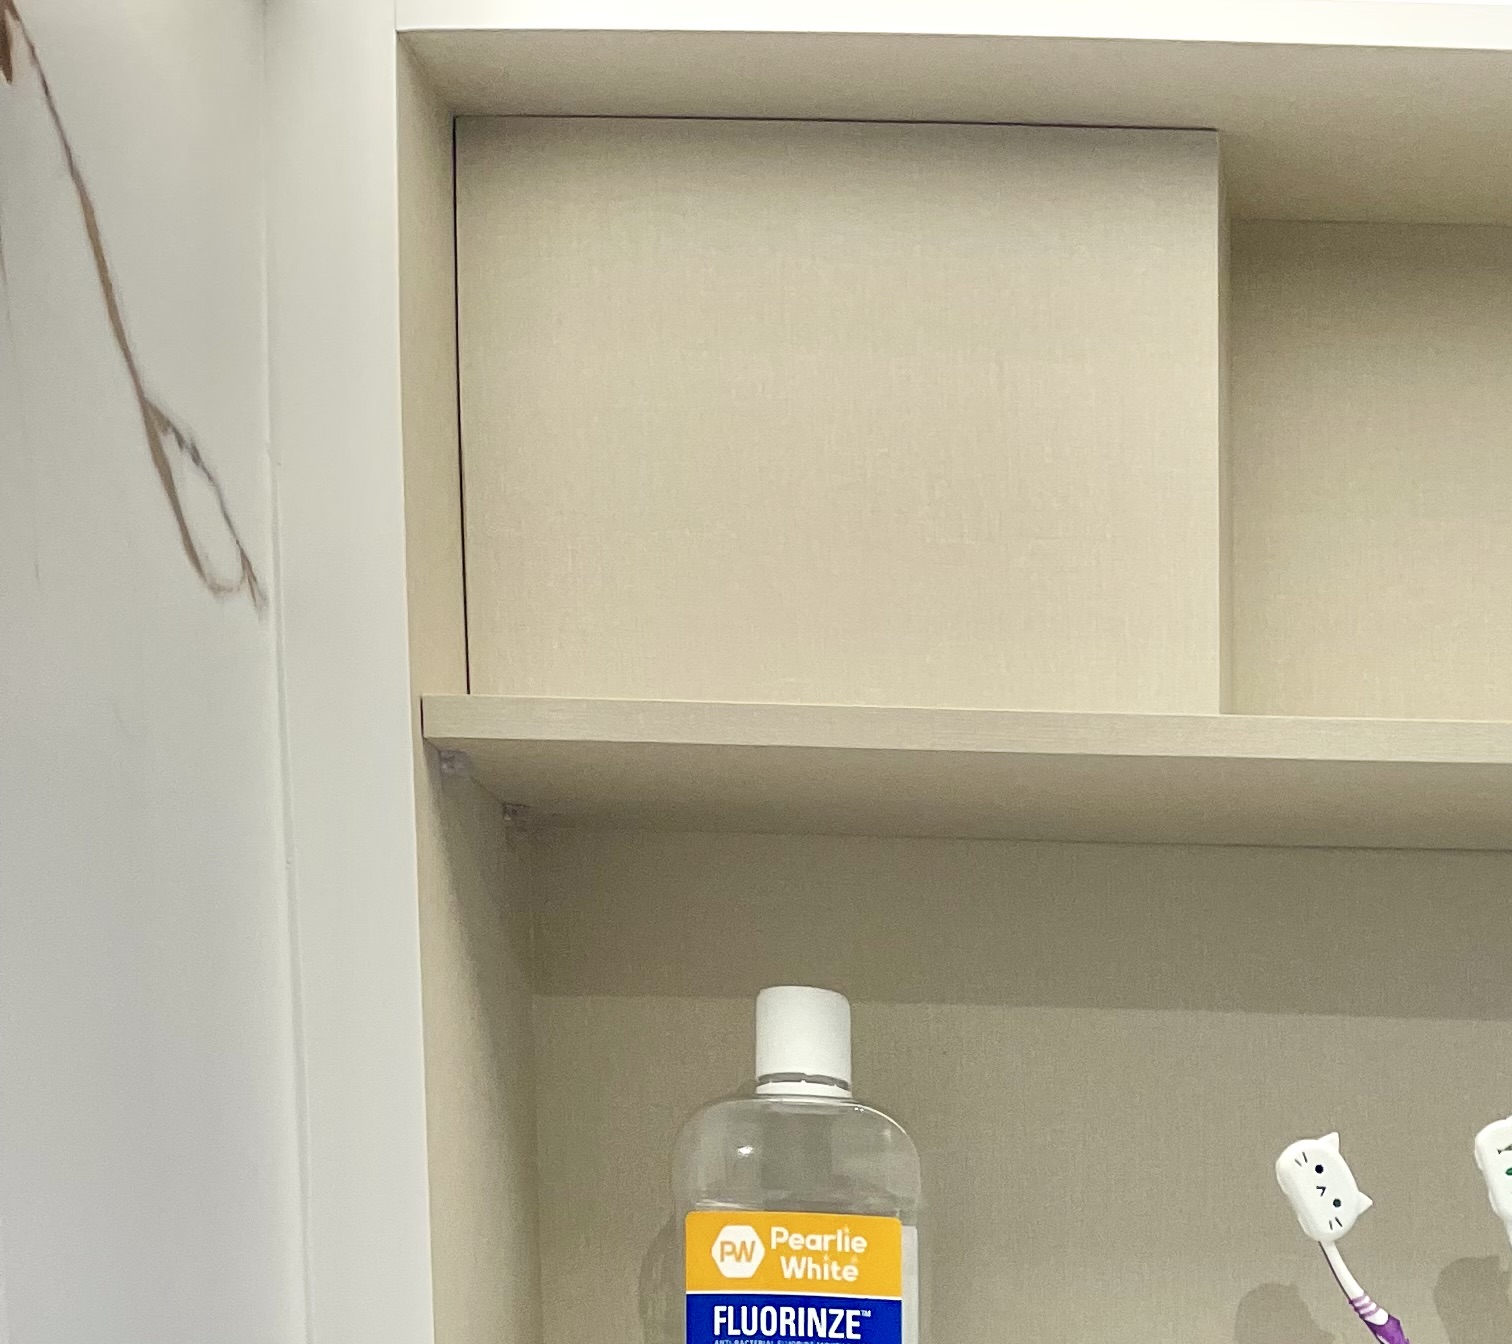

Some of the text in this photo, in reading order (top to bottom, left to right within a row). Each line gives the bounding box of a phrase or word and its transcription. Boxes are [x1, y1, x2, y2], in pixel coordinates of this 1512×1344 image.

[720, 1241, 756, 1262] PW
[770, 1226, 868, 1254] Pearlie
[780, 1256, 859, 1281] White
